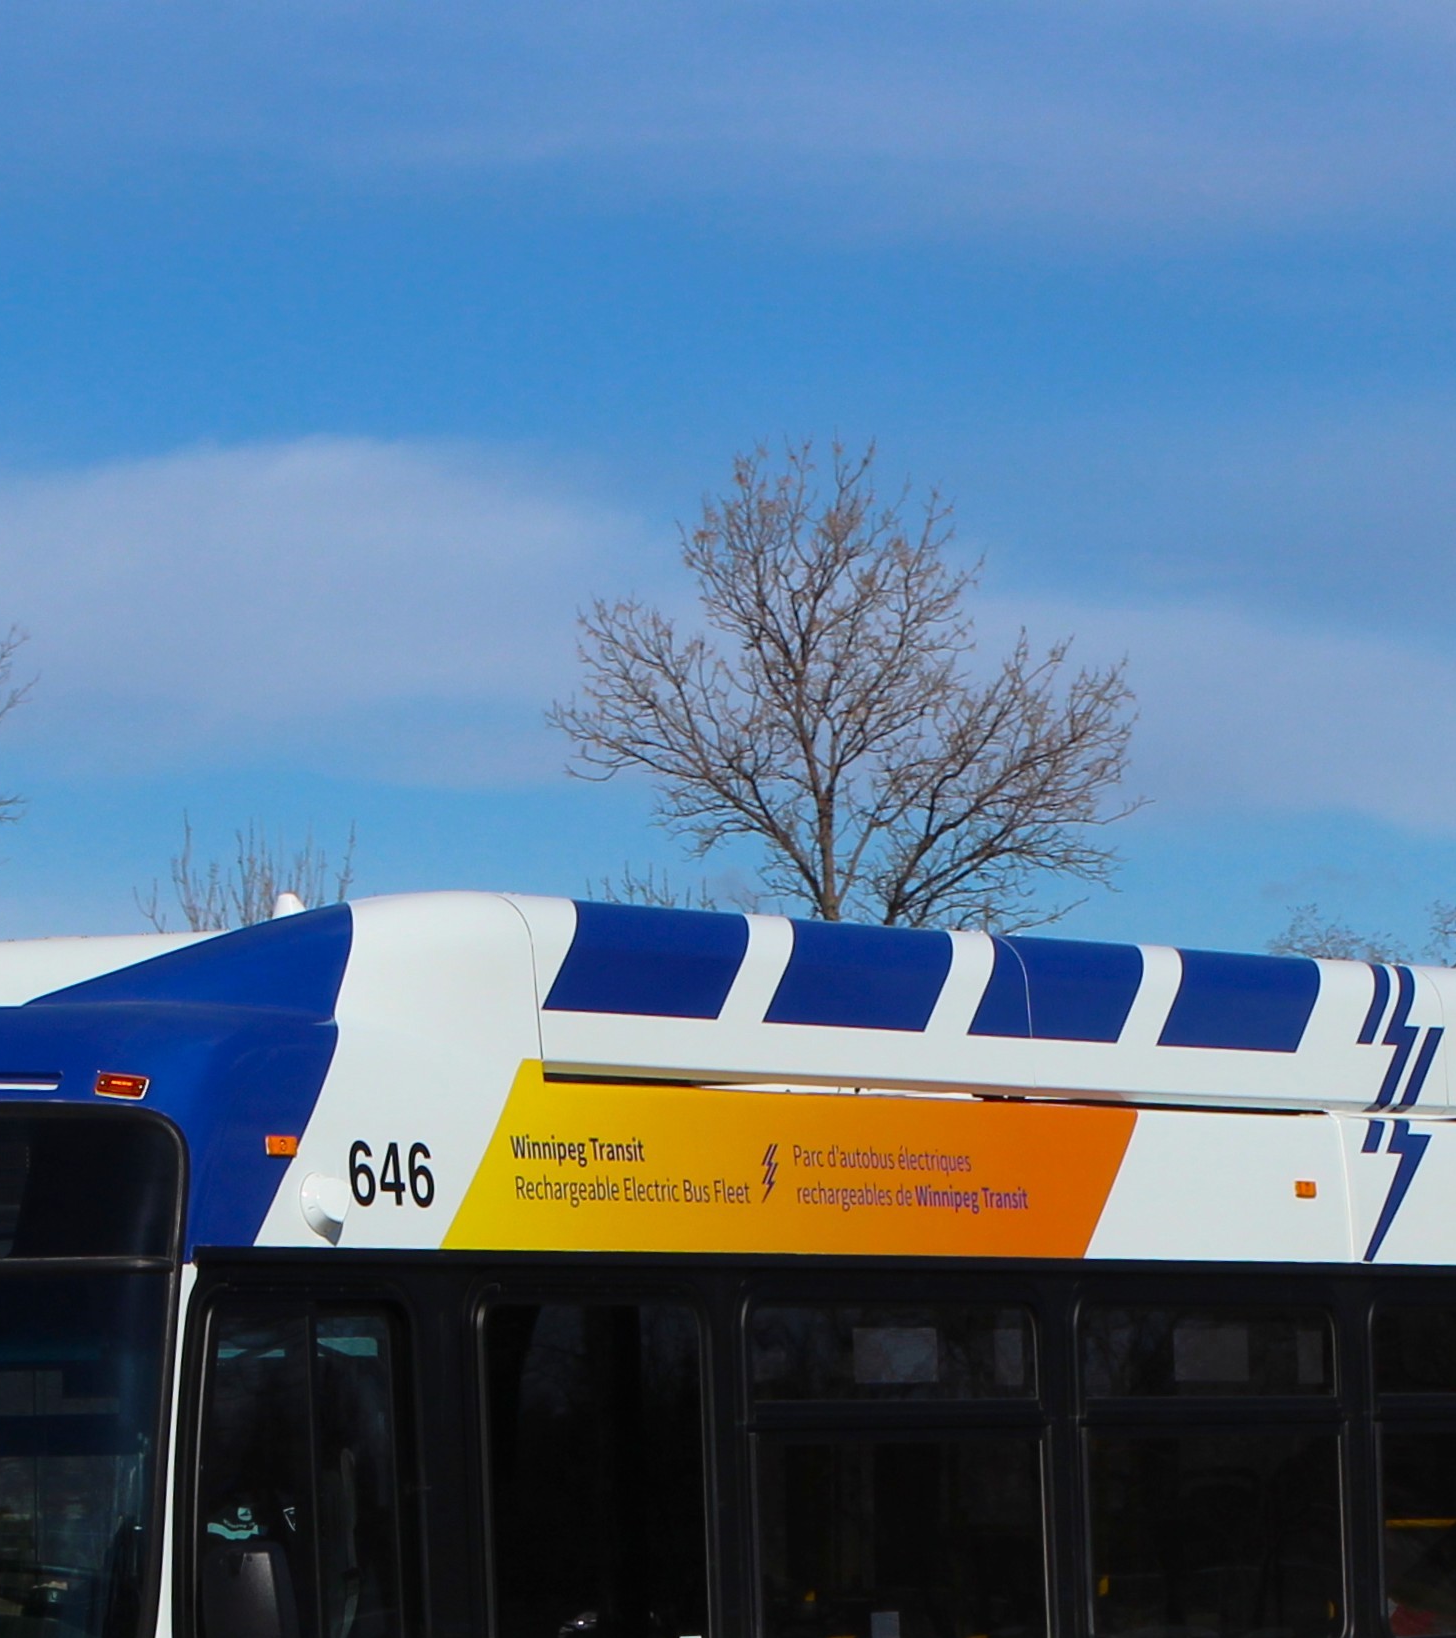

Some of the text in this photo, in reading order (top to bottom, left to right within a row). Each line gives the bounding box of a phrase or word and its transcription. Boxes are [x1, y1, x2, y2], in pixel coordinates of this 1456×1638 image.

[510, 1134, 645, 1168] Winnipeg Transit
[793, 1144, 972, 1176] Parc d'autobus électriques
[348, 1139, 435, 1208] 646
[514, 1174, 751, 1208] Rechargeable Electric Bus Fleet
[796, 1181, 1029, 1214] rechargeables de Winnipeg Transit
